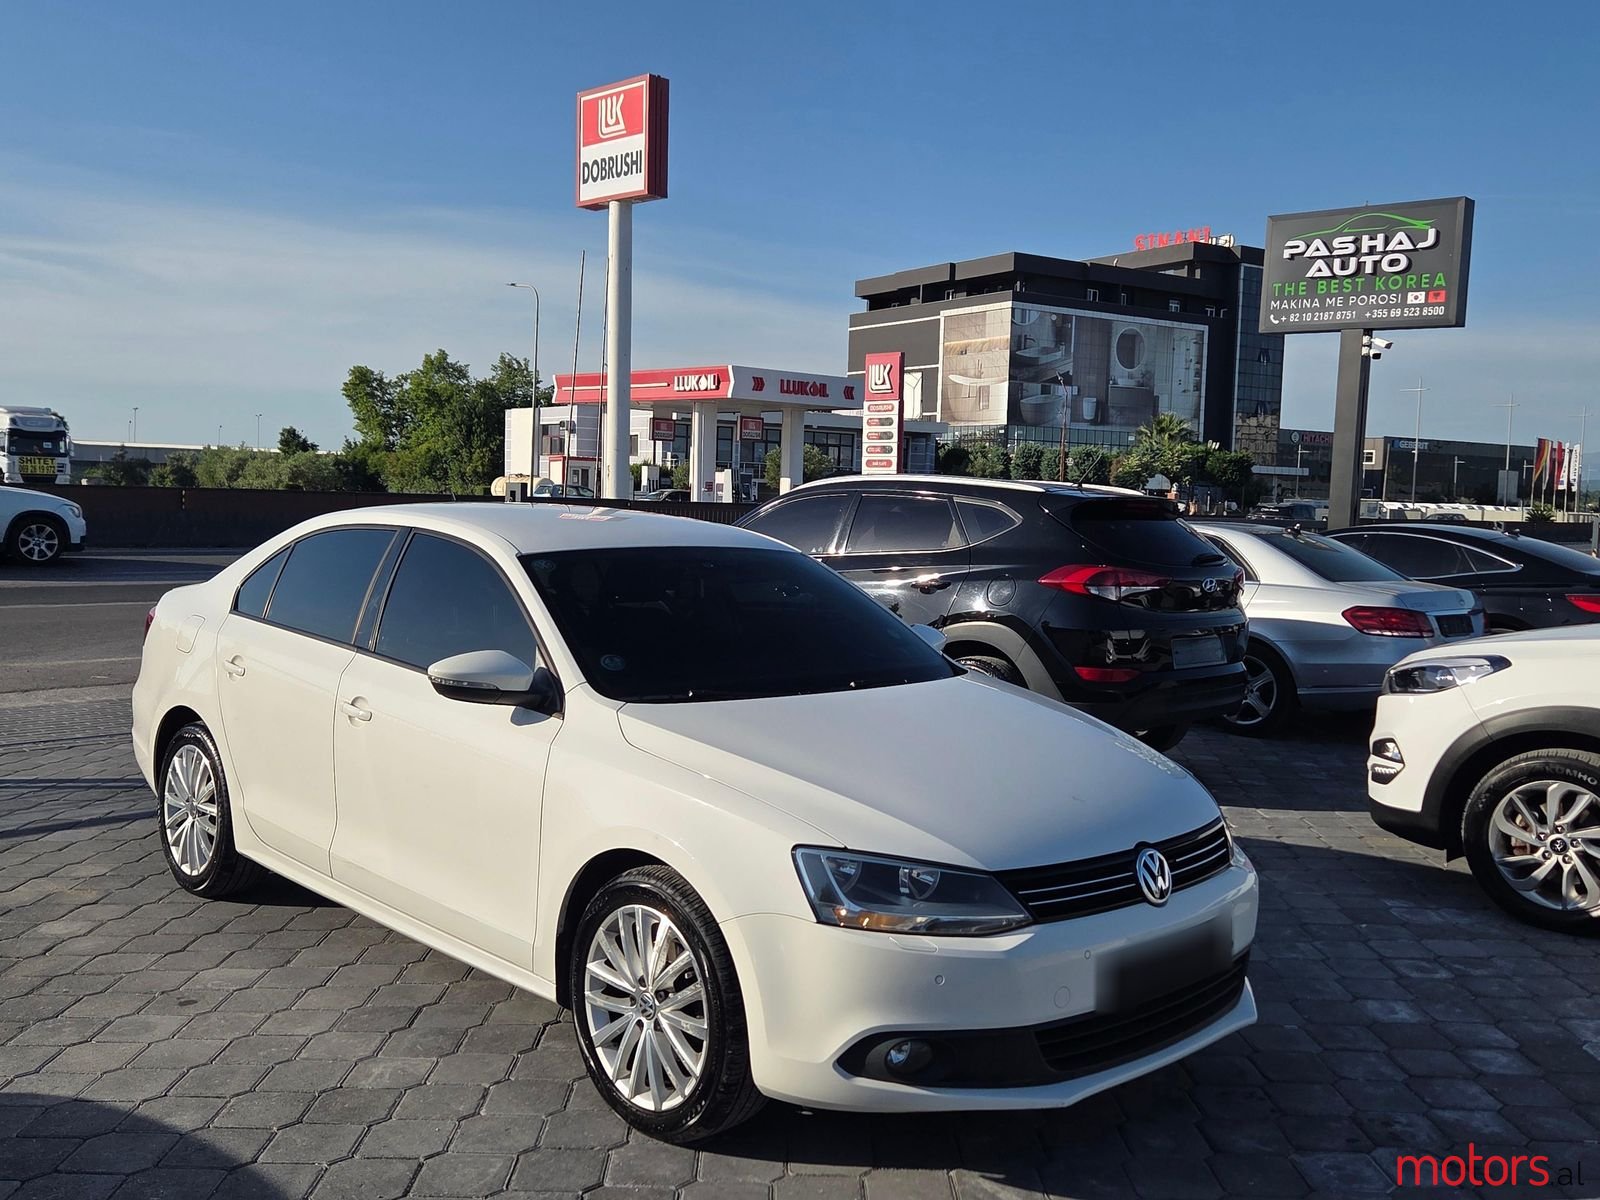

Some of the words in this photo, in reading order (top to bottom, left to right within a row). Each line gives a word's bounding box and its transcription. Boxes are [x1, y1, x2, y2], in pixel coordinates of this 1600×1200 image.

[582, 149, 643, 185] DOBRUSHI
[1283, 228, 1437, 259] PASHAJ
[1305, 253, 1410, 278] AUTO
[1273, 282, 1307, 297] THE
[1317, 277, 1365, 295] BEST
[1375, 272, 1446, 291] KOREA
[1270, 297, 1320, 310] MAKINA
[1325, 296, 1344, 308] ME
[1349, 293, 1402, 306] POROSI
[1289, 312, 1300, 322] 82
[1302, 311, 1312, 321] 10
[1365, 308, 1388, 319] +355
[1390, 307, 1401, 318] 69
[1403, 306, 1420, 317] 523
[1422, 305, 1445, 316] 8500
[18, 456, 56, 465] SHITET
